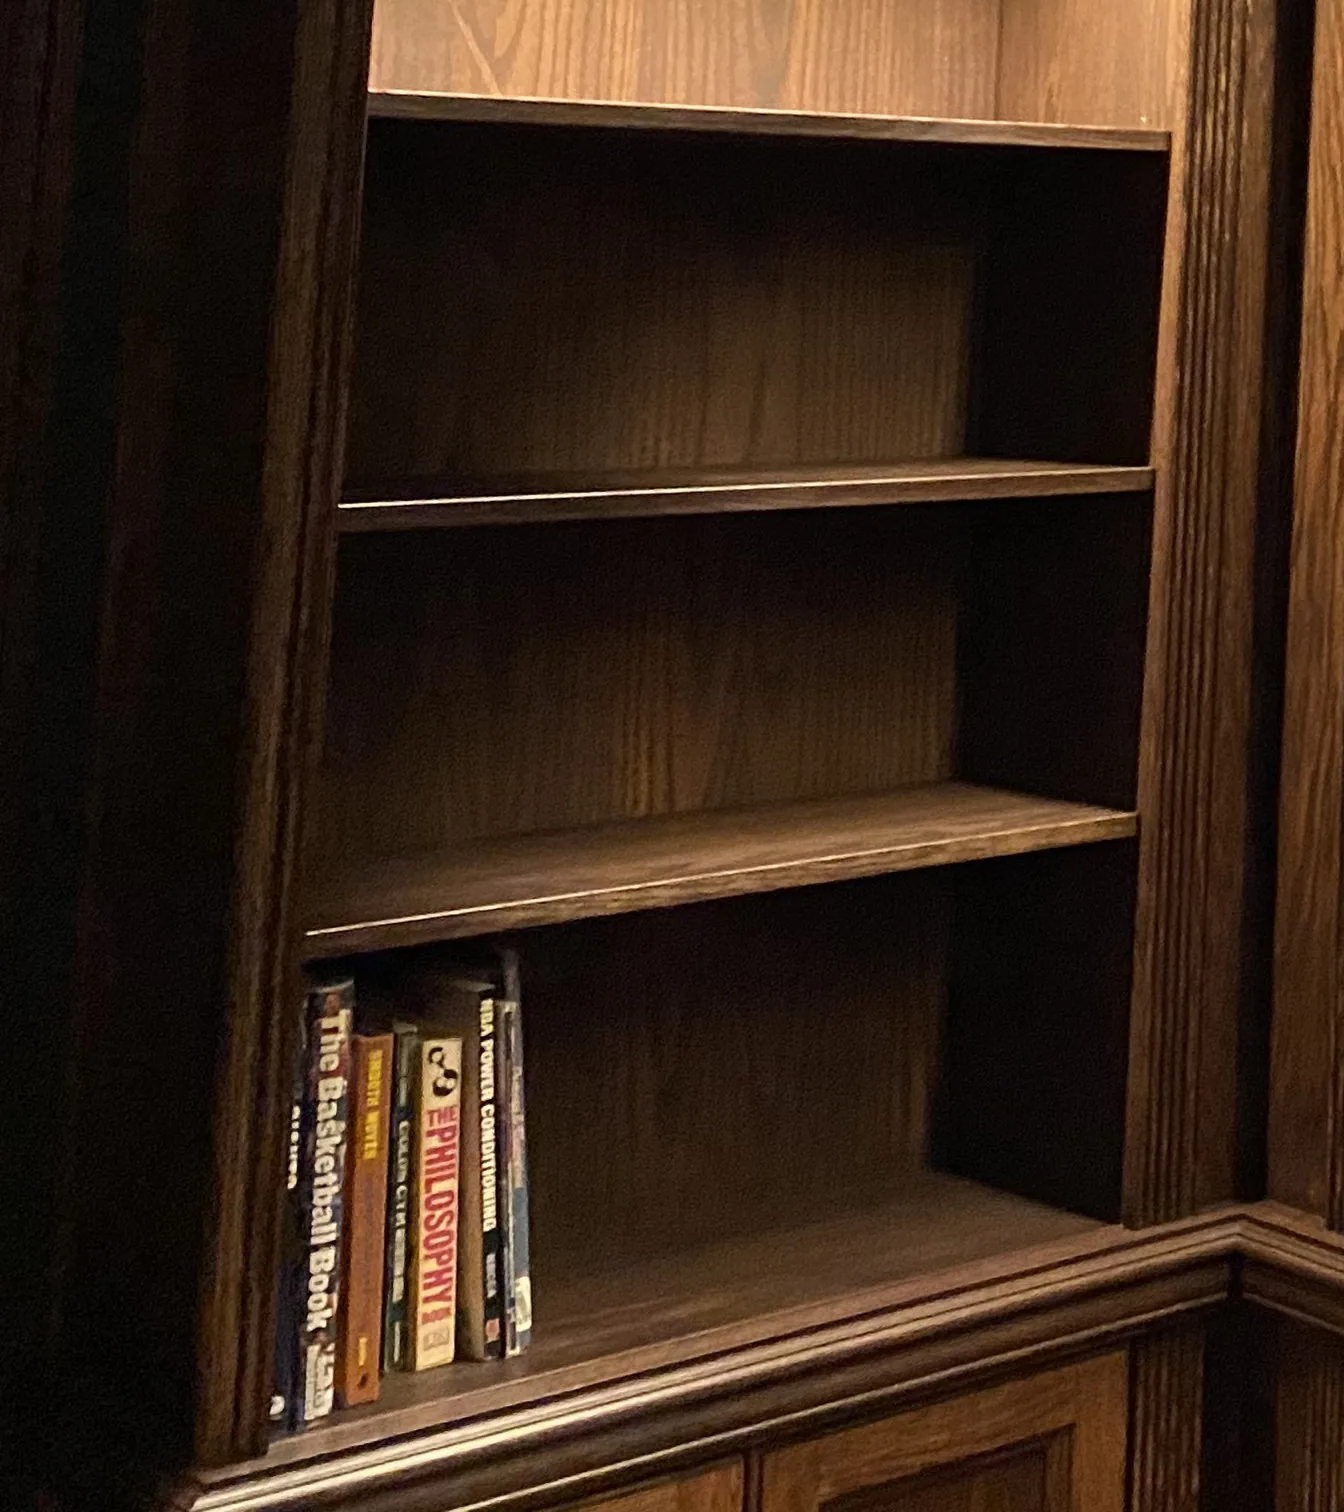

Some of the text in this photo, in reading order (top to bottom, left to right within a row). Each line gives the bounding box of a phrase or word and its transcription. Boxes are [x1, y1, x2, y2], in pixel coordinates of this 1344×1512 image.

[317, 1009, 352, 1073] The
[480, 998, 498, 1233] NBA POWER CONDITIONING
[309, 1078, 348, 1246] Basketball
[424, 1124, 459, 1309] PHILOSOPHY
[306, 1245, 338, 1333] Book
